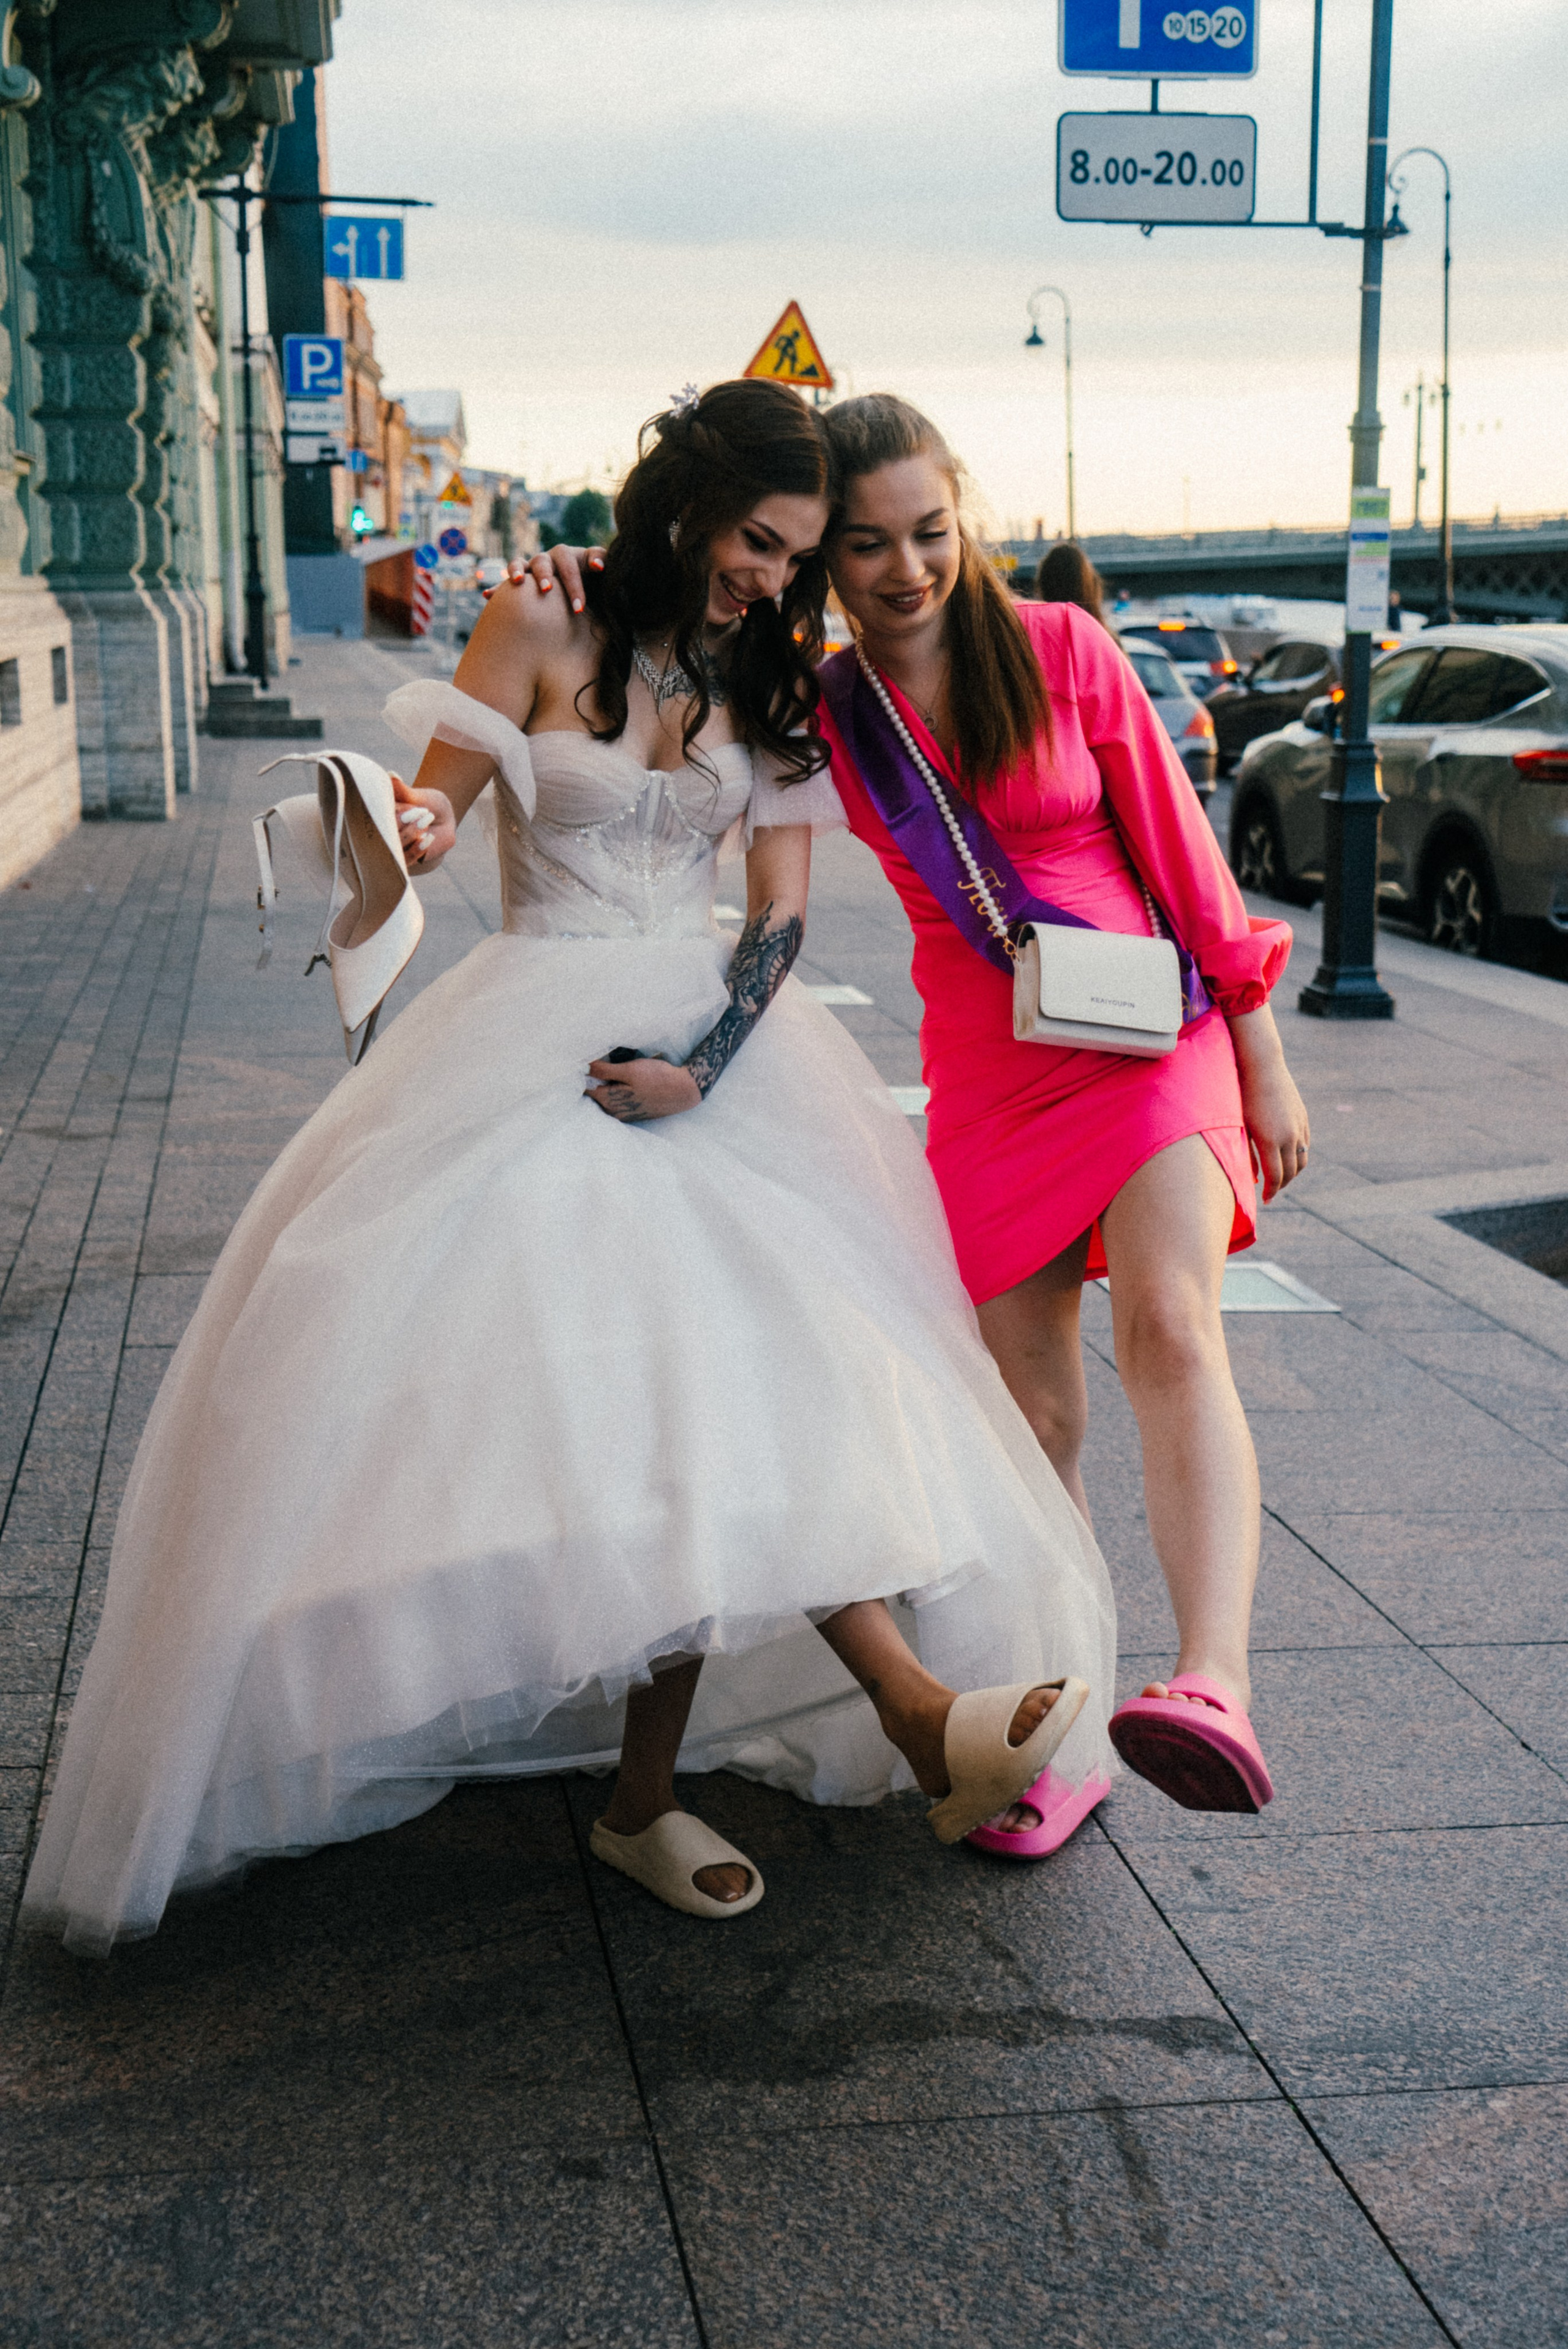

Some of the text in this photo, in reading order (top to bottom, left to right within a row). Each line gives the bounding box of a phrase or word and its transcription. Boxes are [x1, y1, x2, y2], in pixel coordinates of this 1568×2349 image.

[1169, 16, 1242, 38] 10 15 20
[1070, 149, 1244, 186] 8.00-20.00
[301, 343, 333, 390] P
